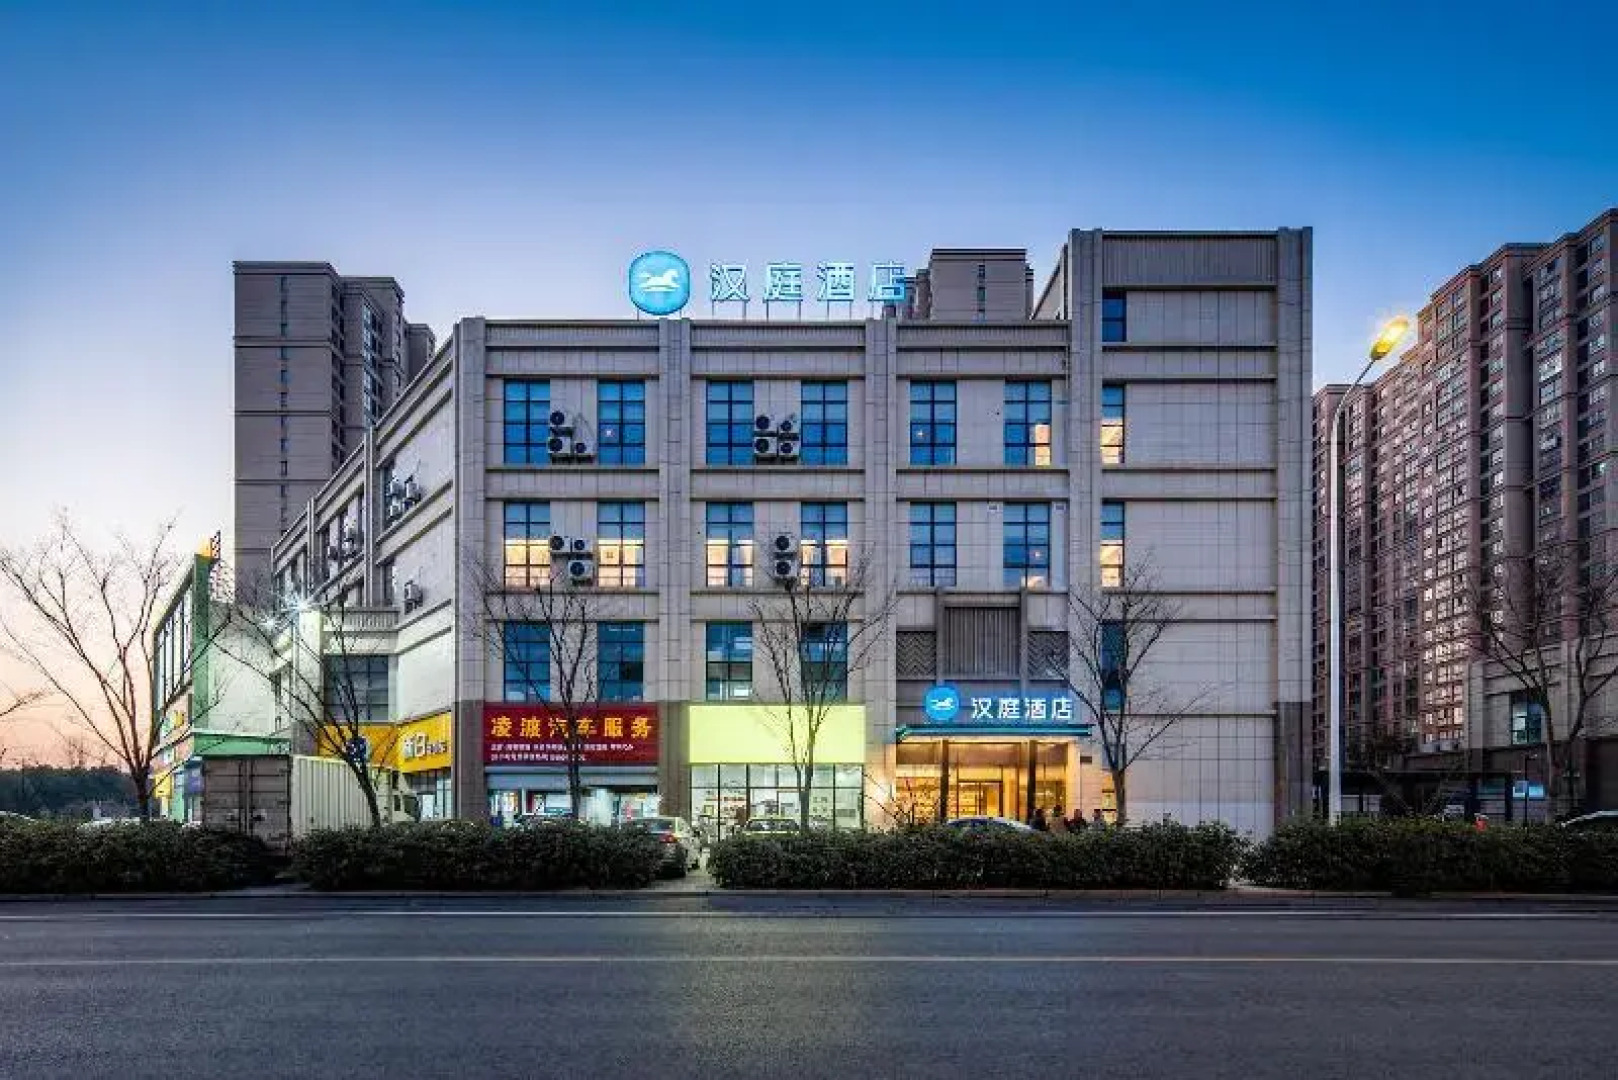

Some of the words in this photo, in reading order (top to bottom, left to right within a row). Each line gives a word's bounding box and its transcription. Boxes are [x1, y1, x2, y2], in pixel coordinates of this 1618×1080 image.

[710, 260, 905, 301] 汉庭酒店
[971, 696, 1073, 719] 汉庭酒店
